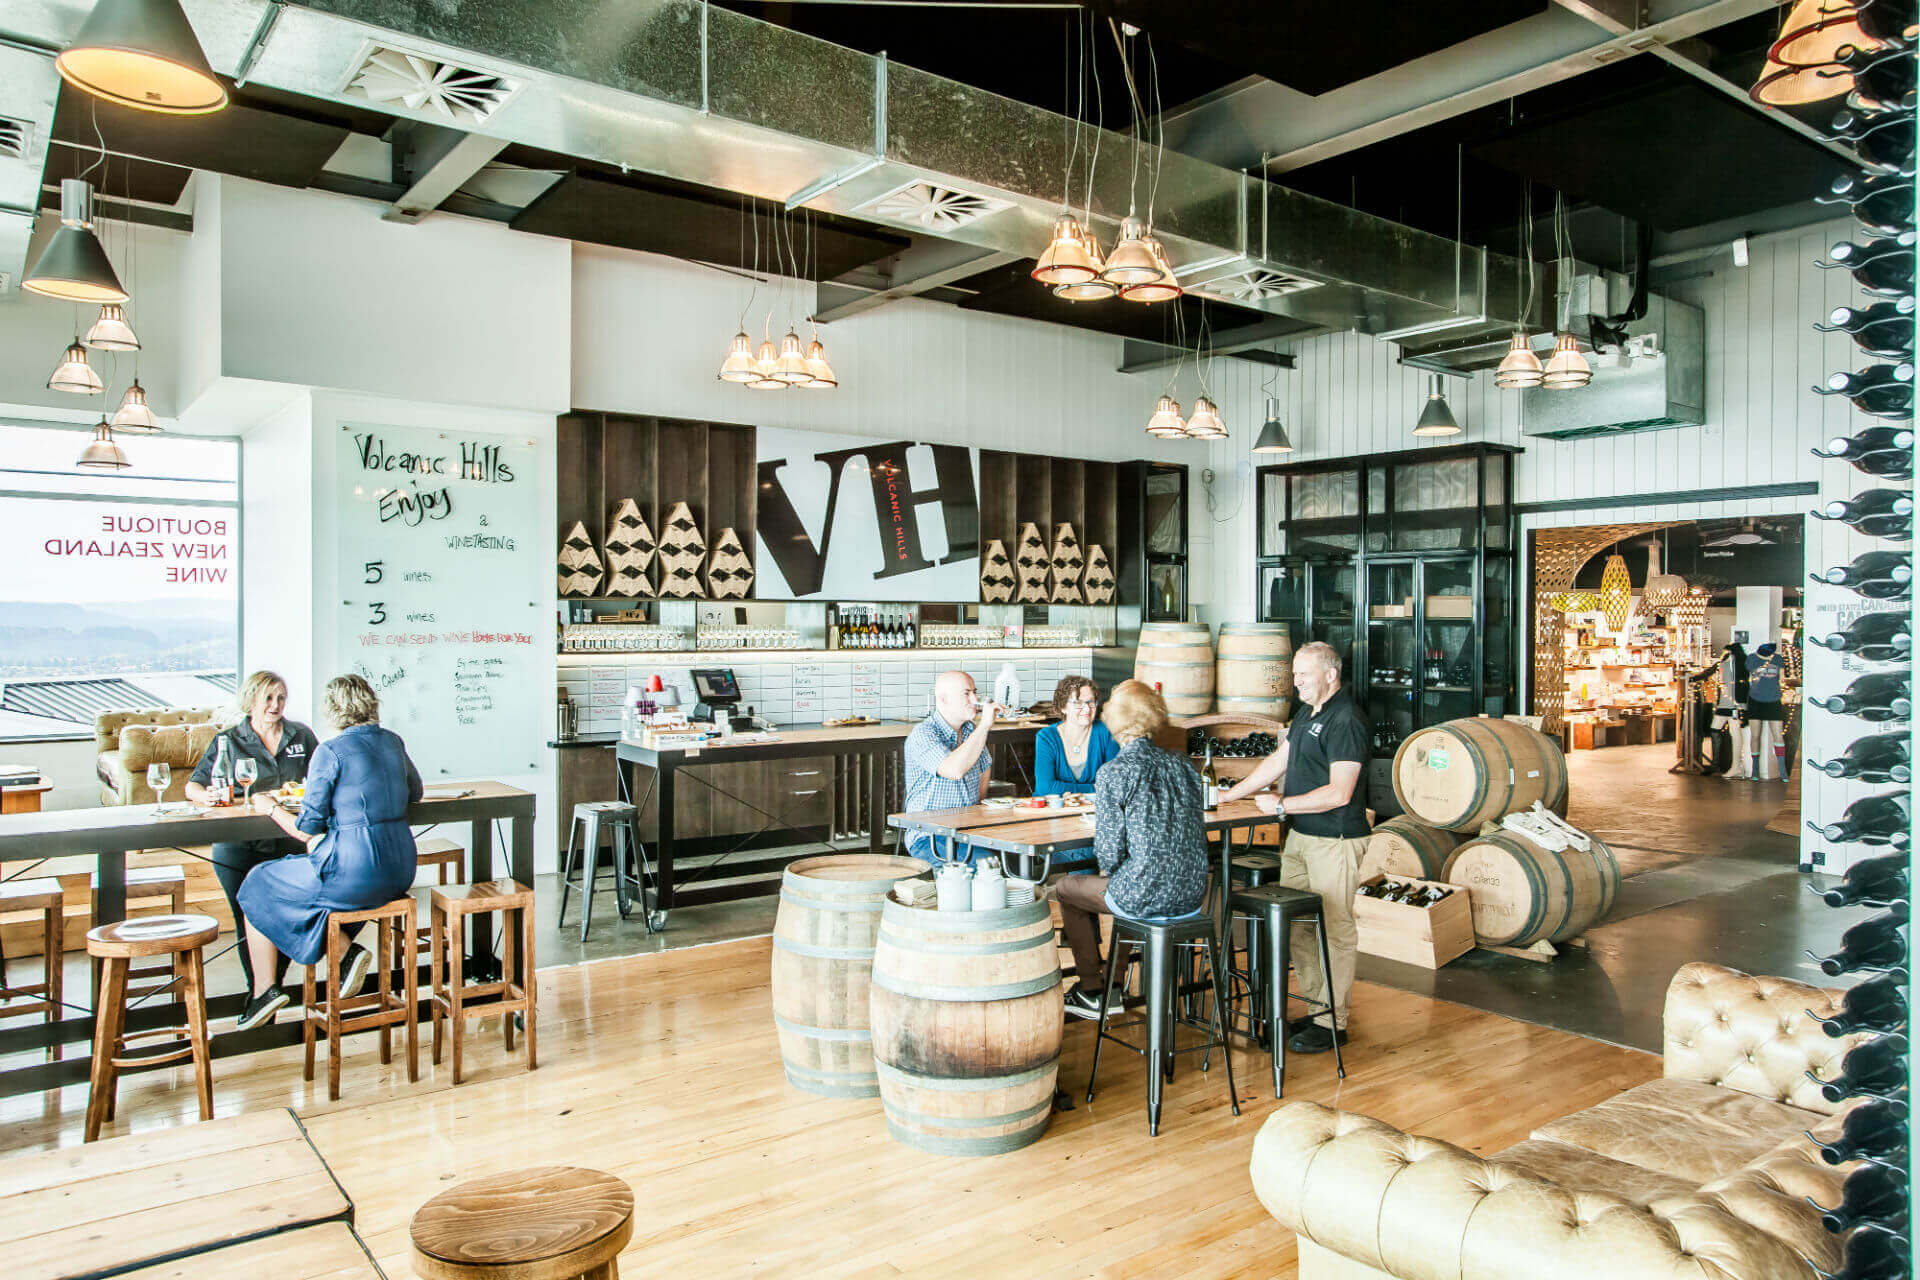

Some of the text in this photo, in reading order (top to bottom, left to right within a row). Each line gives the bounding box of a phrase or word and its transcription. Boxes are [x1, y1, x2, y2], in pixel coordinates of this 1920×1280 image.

[353, 433, 516, 483] Volcanic Hills
[378, 479, 452, 528] Enjoy
[883, 458, 908, 561] VOLCANIC HILLS
[364, 560, 385, 585] 5
[368, 602, 387, 625] 3
